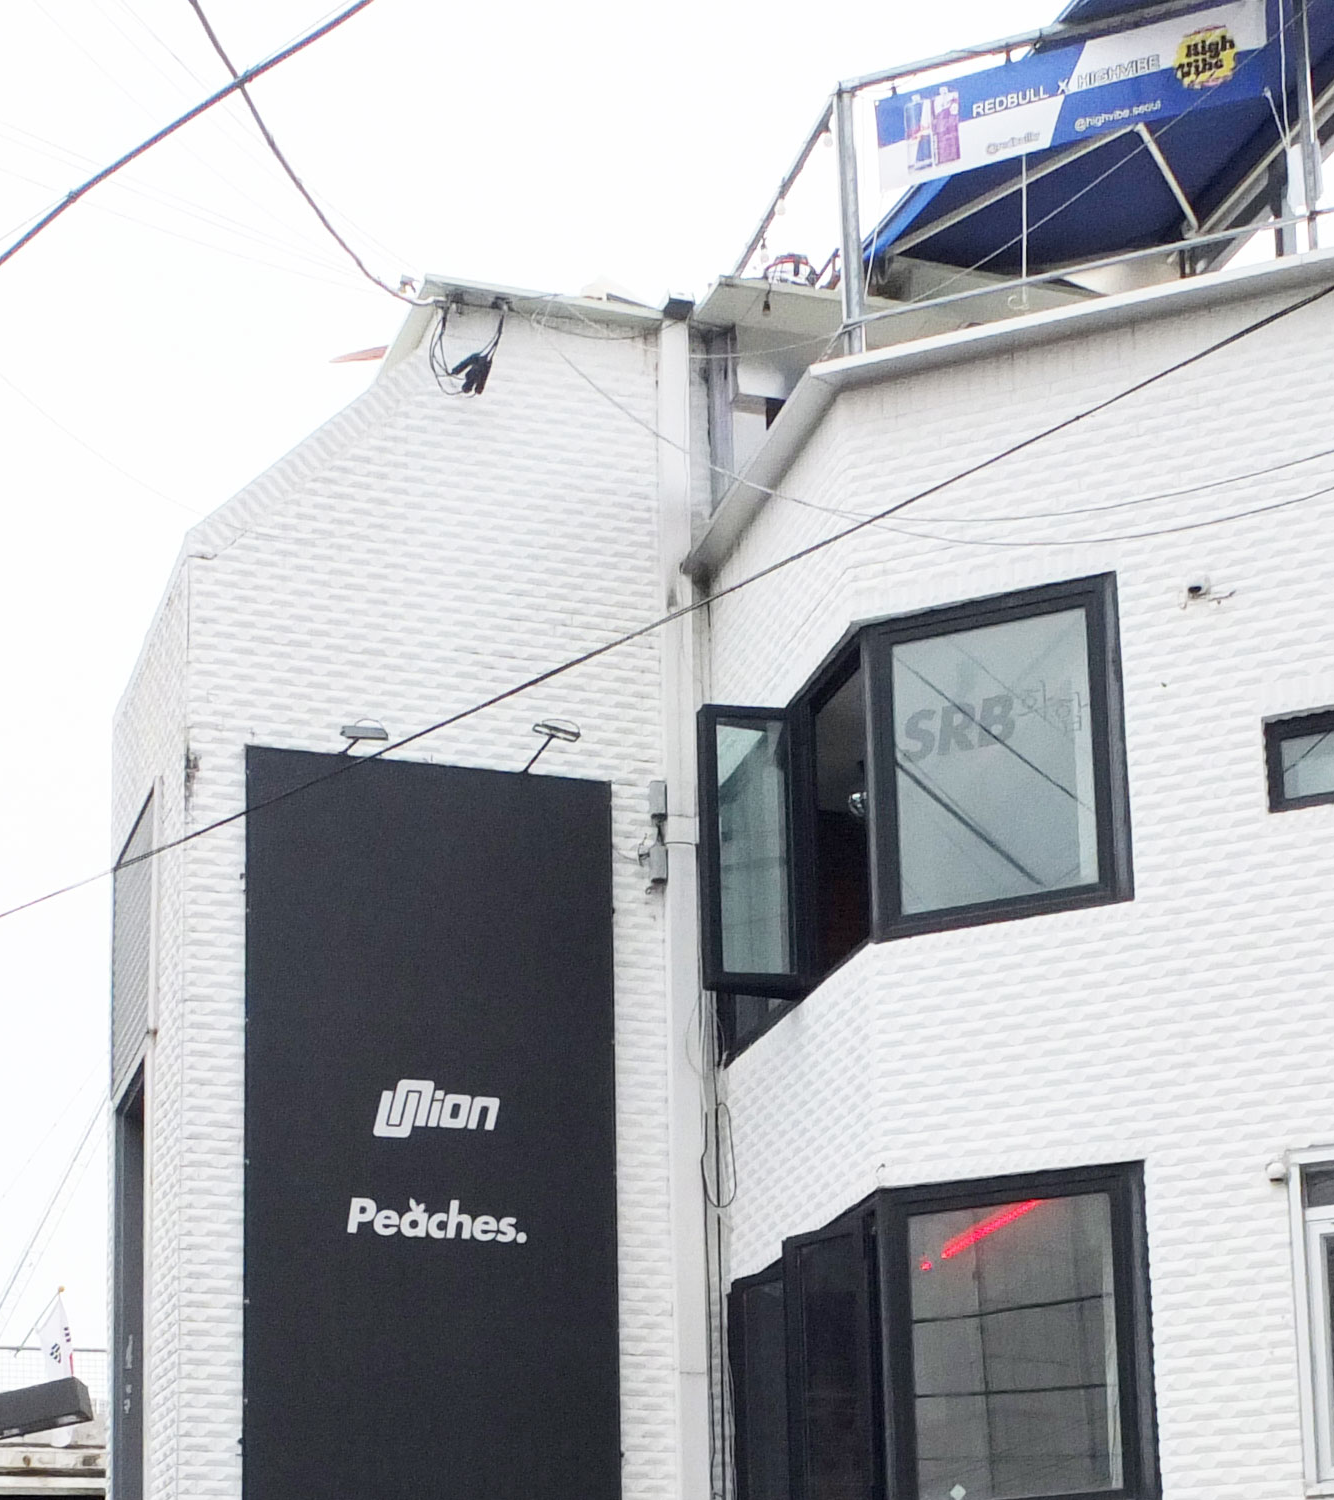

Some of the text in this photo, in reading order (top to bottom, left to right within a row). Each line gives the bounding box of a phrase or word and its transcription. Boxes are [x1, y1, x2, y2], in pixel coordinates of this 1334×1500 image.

[972, 86, 1049, 117] REDBULL
[1077, 54, 1161, 89] HIGHVIBE
[904, 694, 1015, 762] SRB
[373, 1079, 500, 1138] Union
